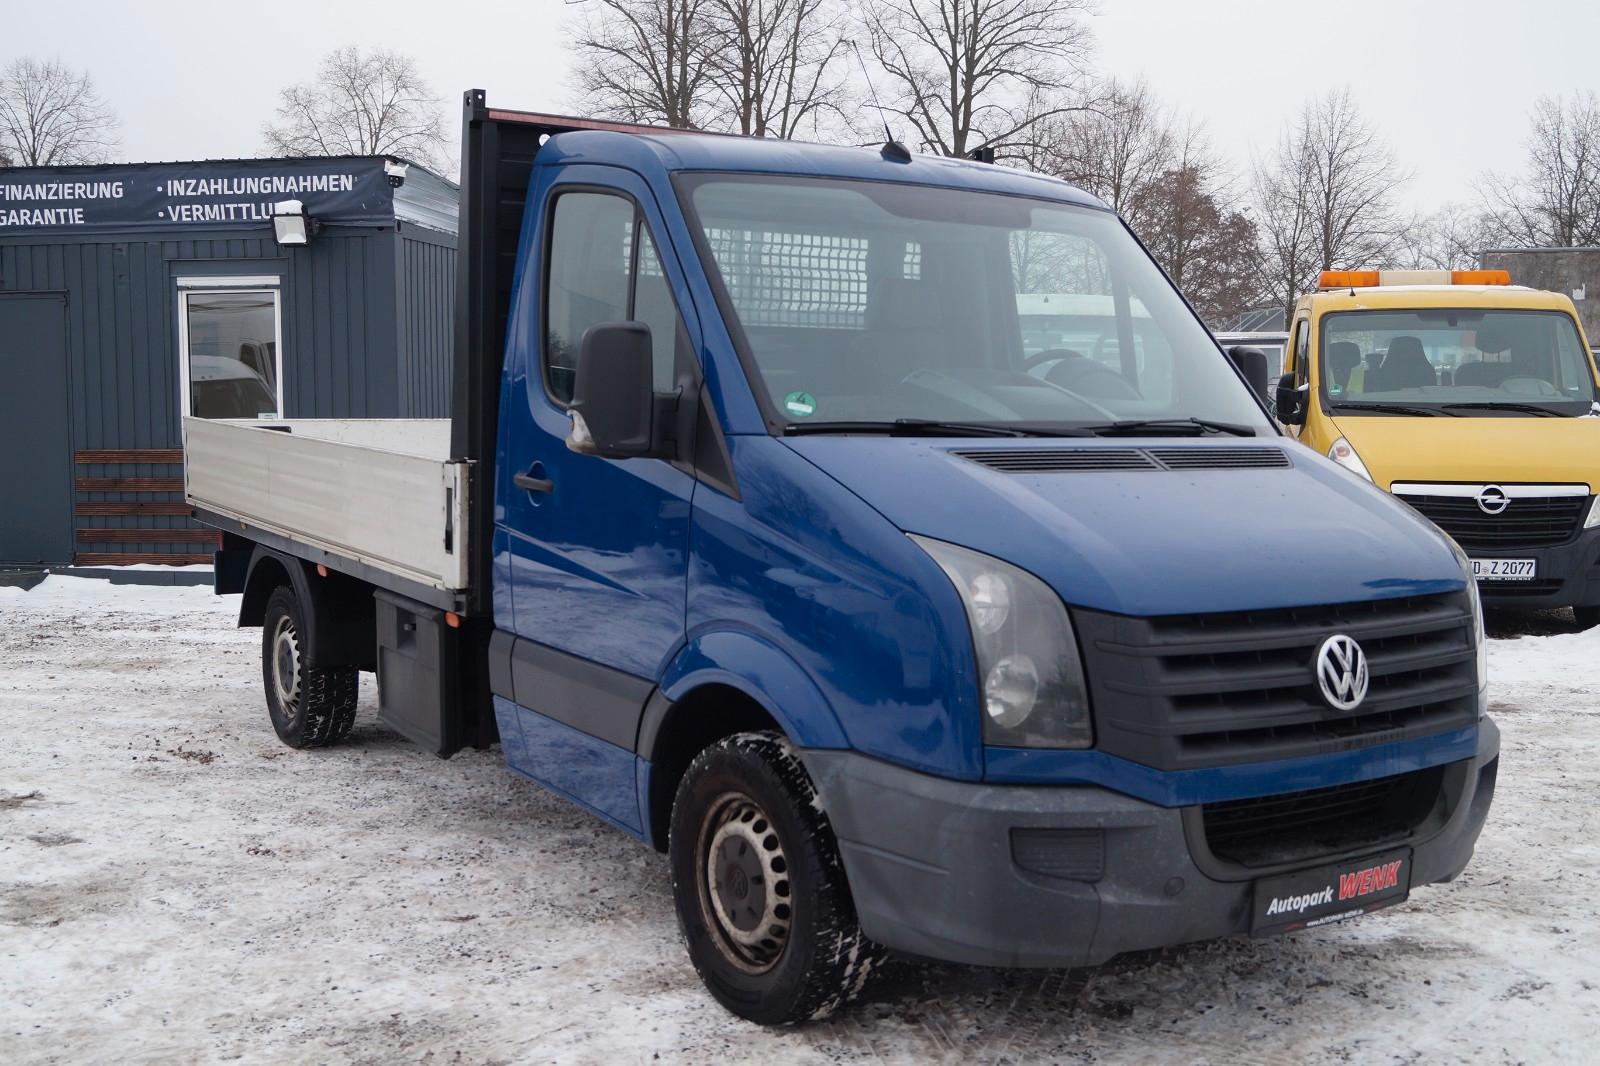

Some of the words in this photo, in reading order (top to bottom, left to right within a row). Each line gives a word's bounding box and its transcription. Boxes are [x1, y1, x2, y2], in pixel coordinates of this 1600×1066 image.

[167, 174, 353, 196] INZAHLUNGNAHMEN
[0, 208, 85, 226] GARANTIE
[168, 202, 274, 222] VERMITTLU
[1470, 561, 1481, 575] D
[1490, 561, 1499, 575] Z
[1502, 561, 1534, 575] 2077
[1266, 885, 1334, 915] Autopark
[1338, 860, 1402, 900] WENK
